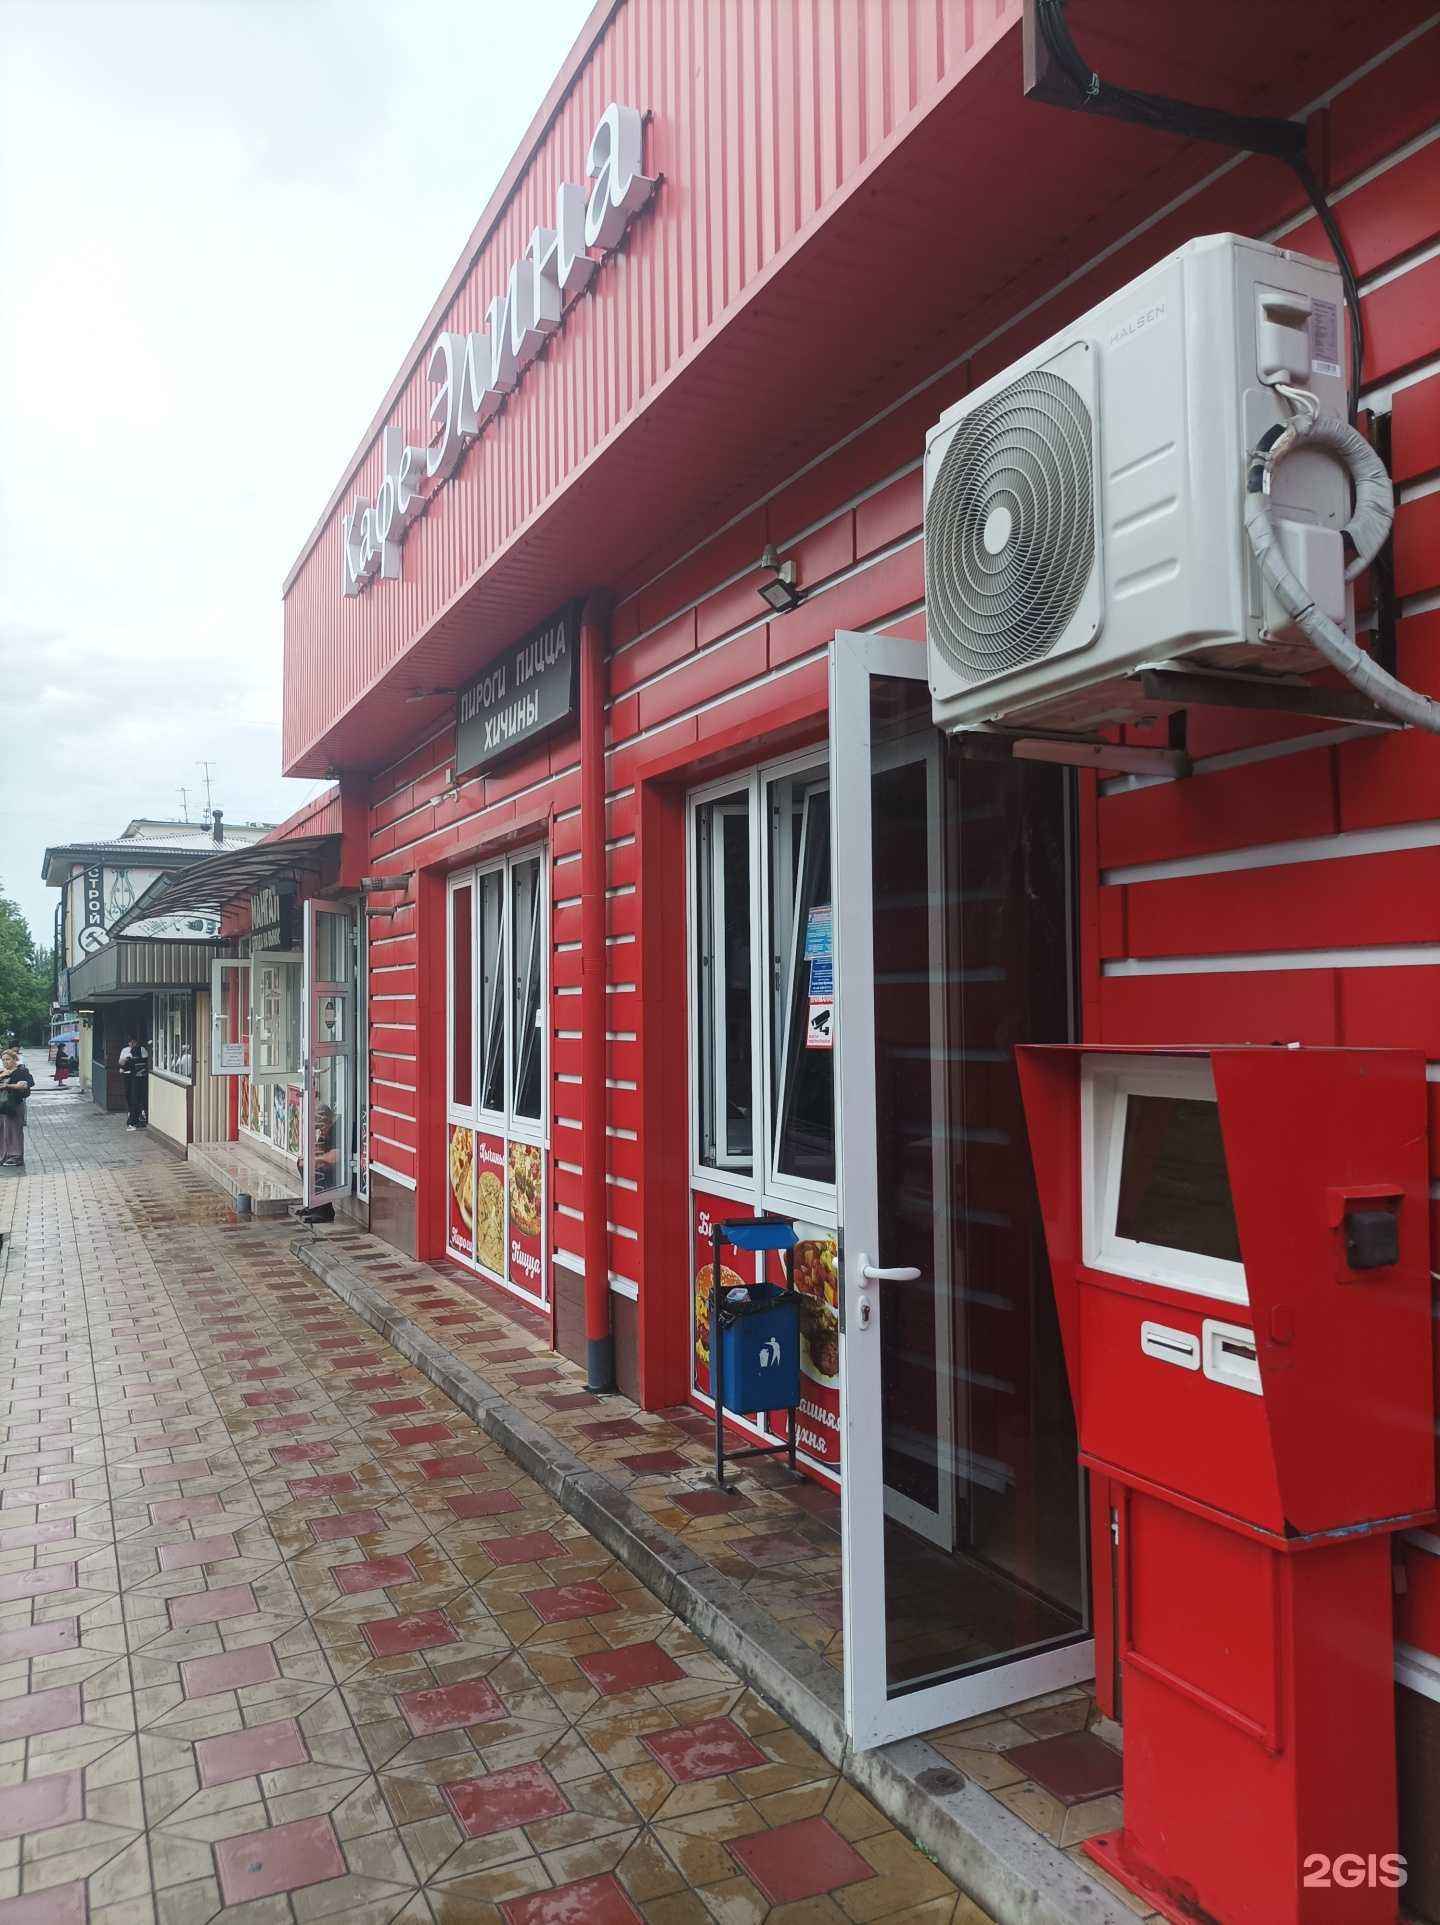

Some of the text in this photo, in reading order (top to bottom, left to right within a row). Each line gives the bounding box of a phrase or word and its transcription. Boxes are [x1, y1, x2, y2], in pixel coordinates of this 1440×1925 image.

[427, 102, 662, 480] Элина
[461, 621, 566, 724] ПИРОГИ ПИЦЦА
[484, 688, 539, 752] ХИЧИНЫ
[88, 868, 101, 924] СТРОЙ
[511, 1239, 541, 1279] Пицца
